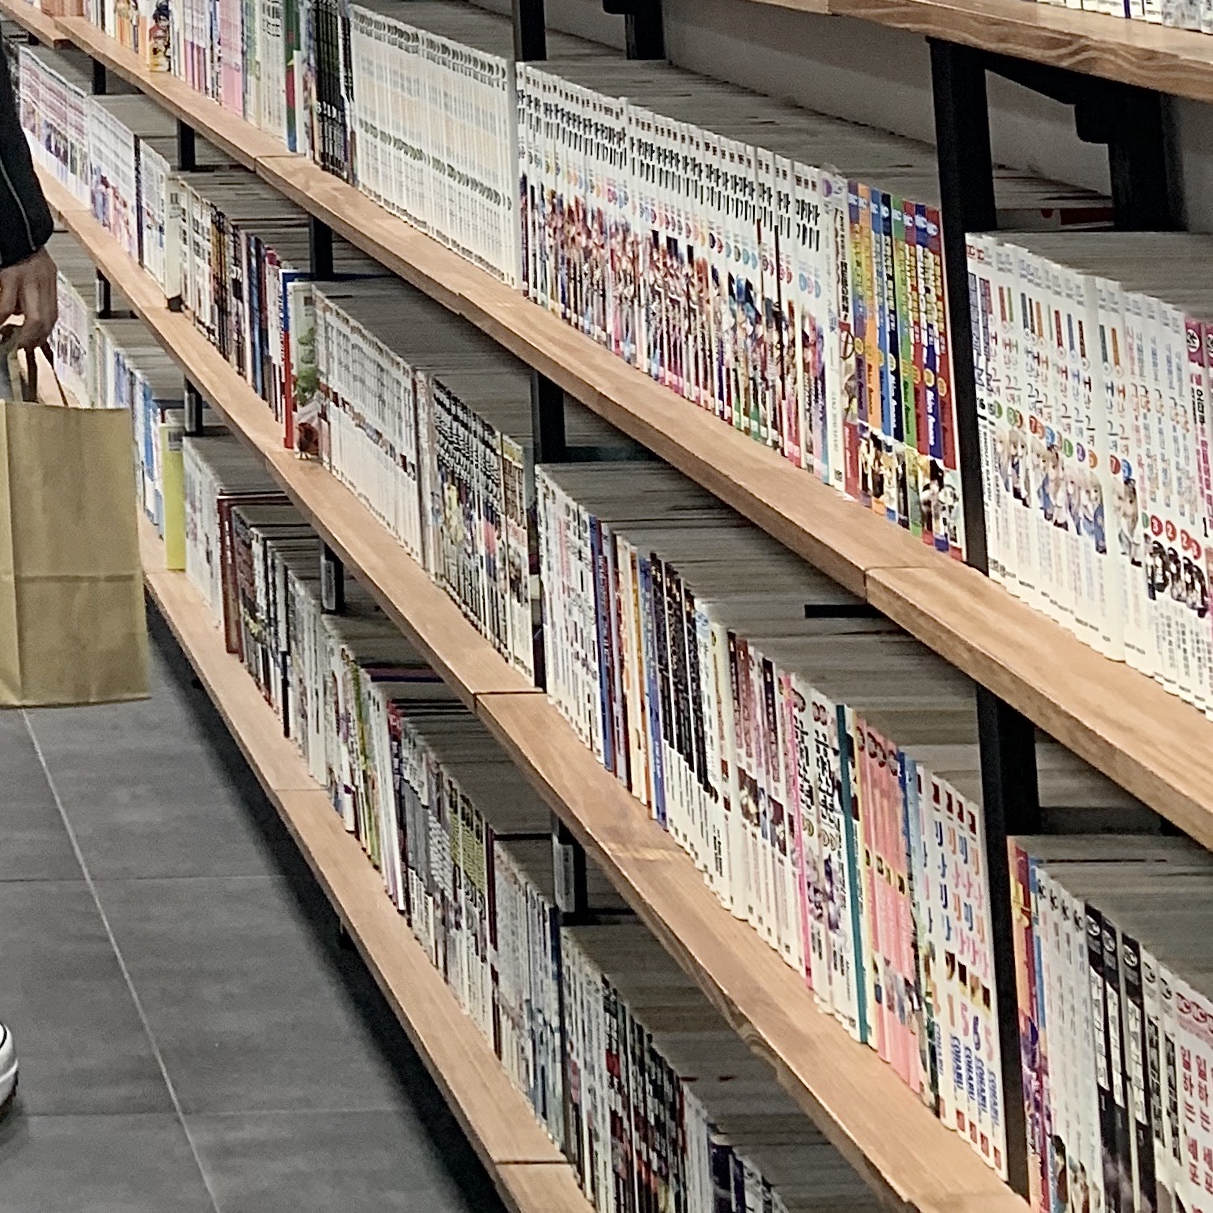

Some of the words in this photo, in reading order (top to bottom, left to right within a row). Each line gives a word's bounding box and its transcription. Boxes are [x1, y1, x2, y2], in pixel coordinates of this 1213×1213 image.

[1180, 1046, 1196, 1124] 일하는
[1188, 1138, 1201, 1186] 세포
[1196, 1055, 1211, 1133] 일하는
